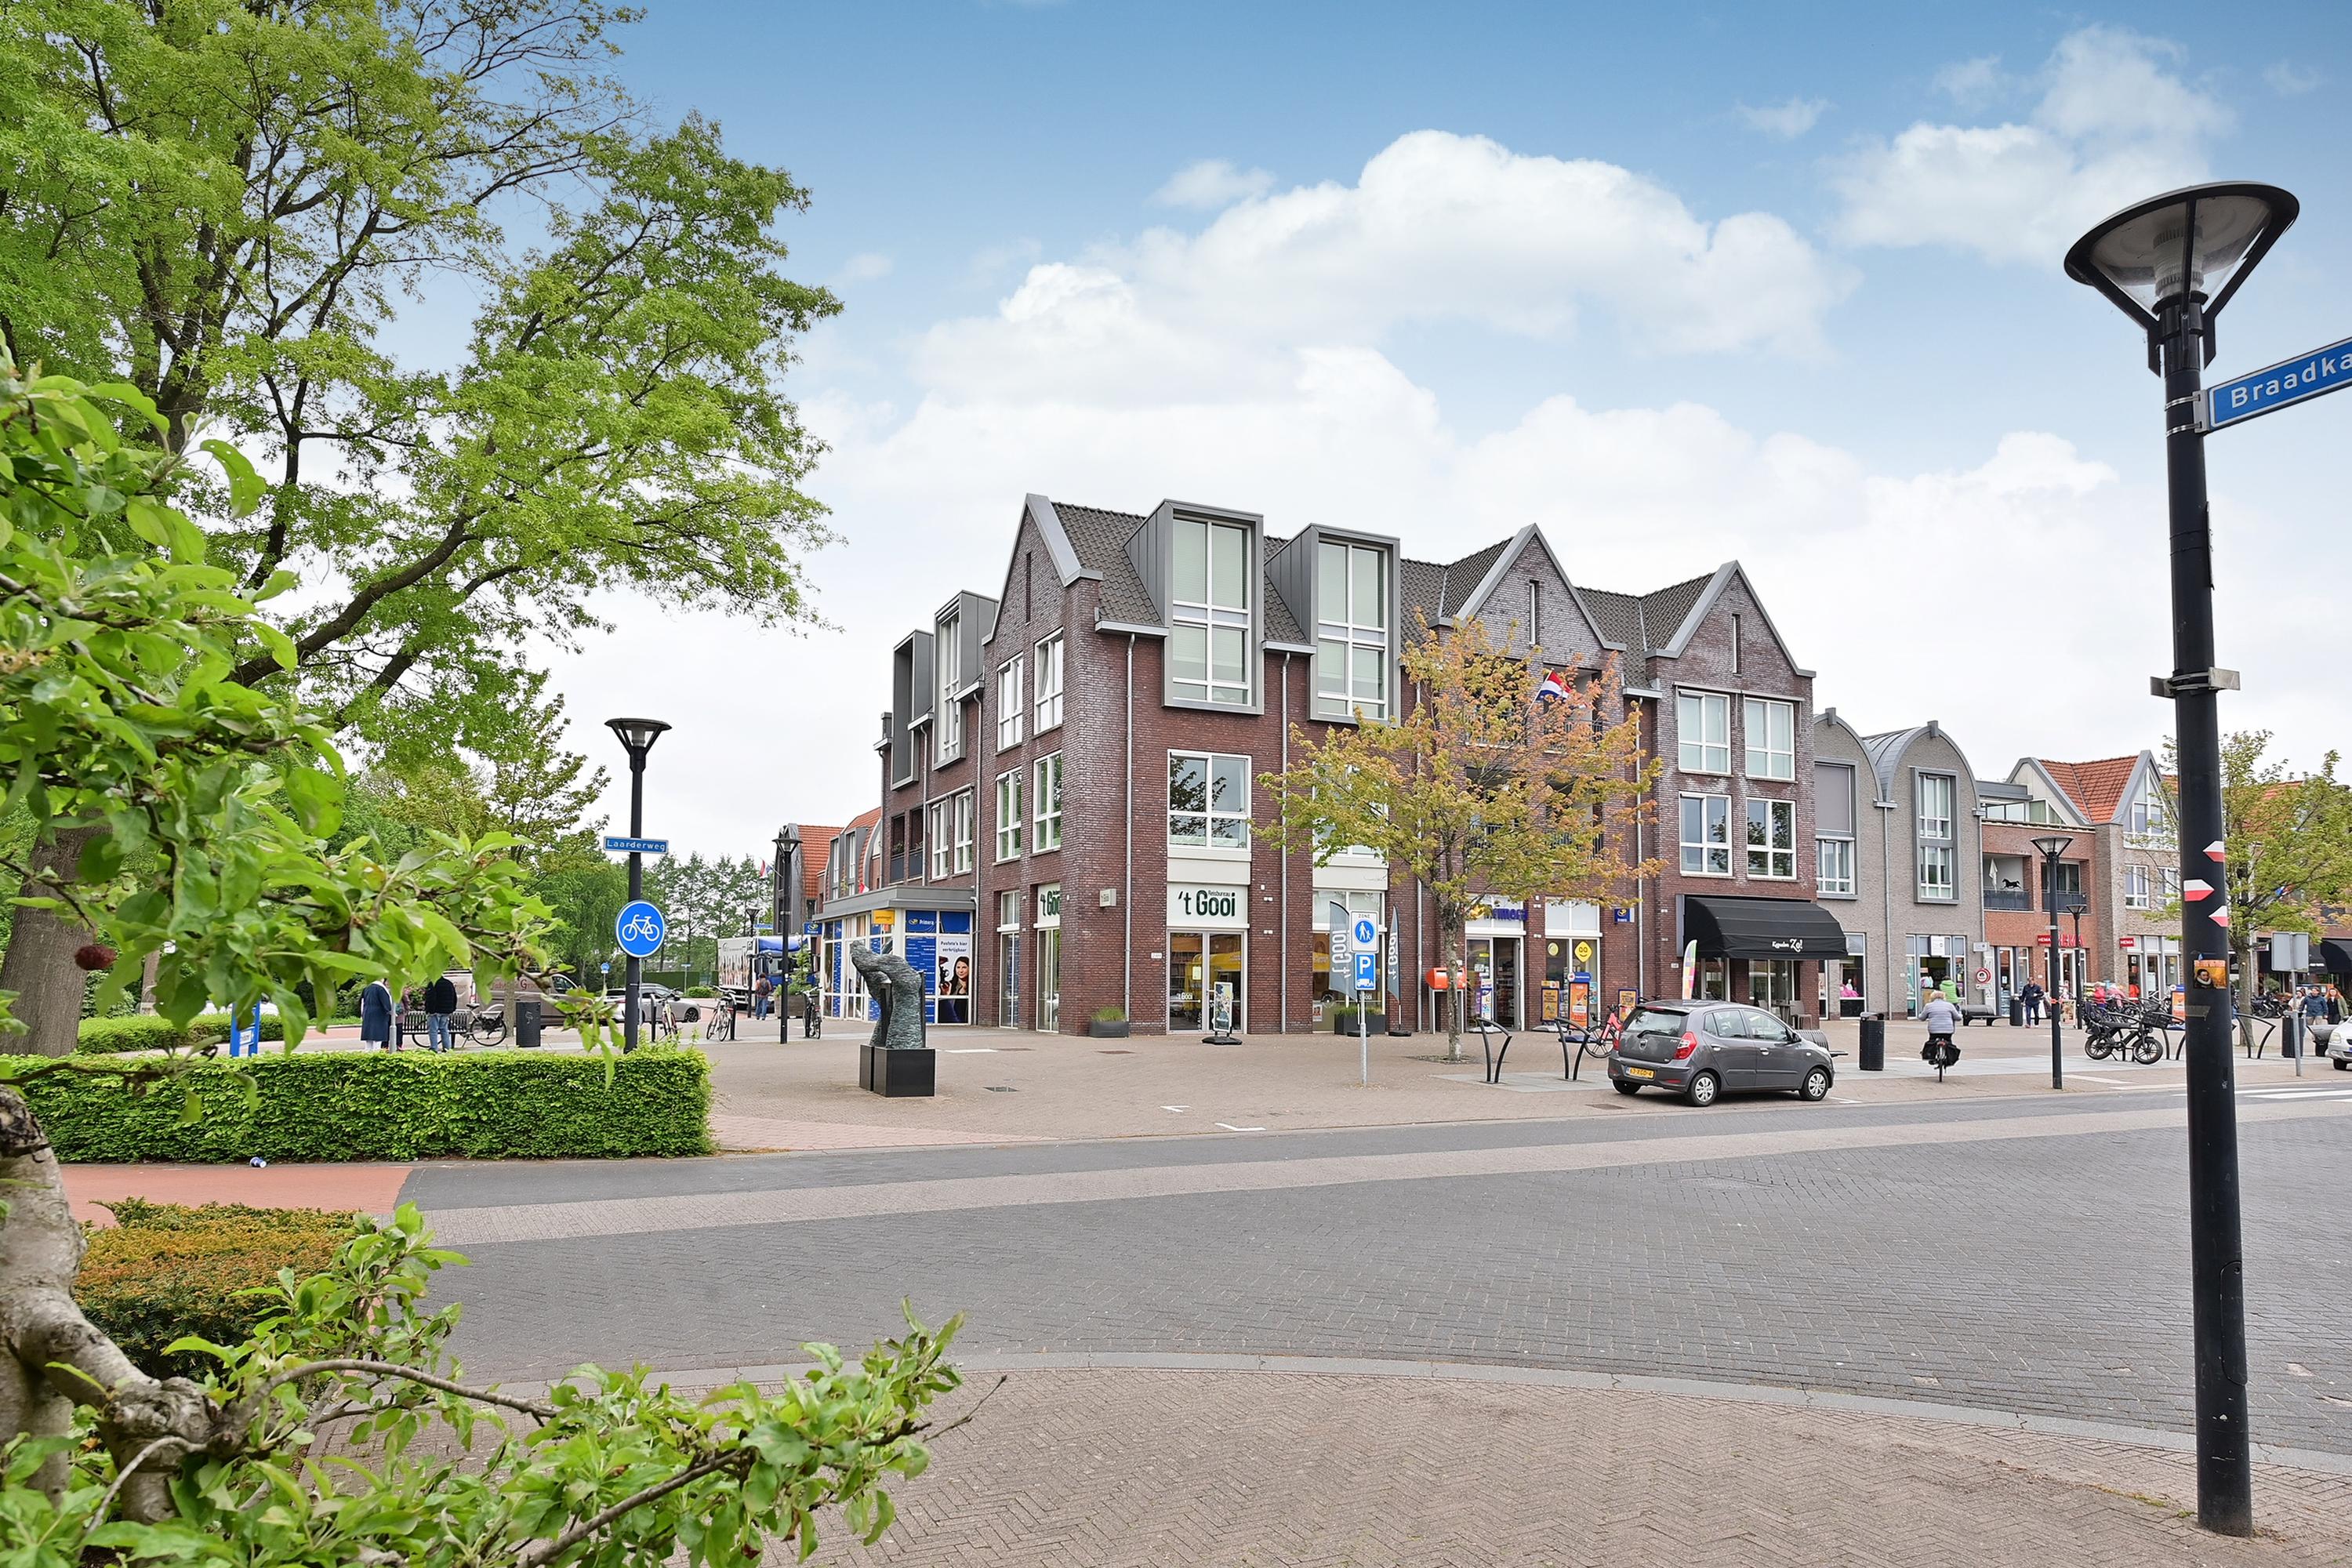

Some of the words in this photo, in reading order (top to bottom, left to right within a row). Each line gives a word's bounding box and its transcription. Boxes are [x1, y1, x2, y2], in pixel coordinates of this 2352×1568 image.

[2231, 352, 2352, 408] Braadka
[607, 840, 666, 852] Laarderweg
[1196, 890, 1236, 916] Gooi
[1790, 938, 1803, 953] Zo!
[1359, 956, 1371, 975] P
